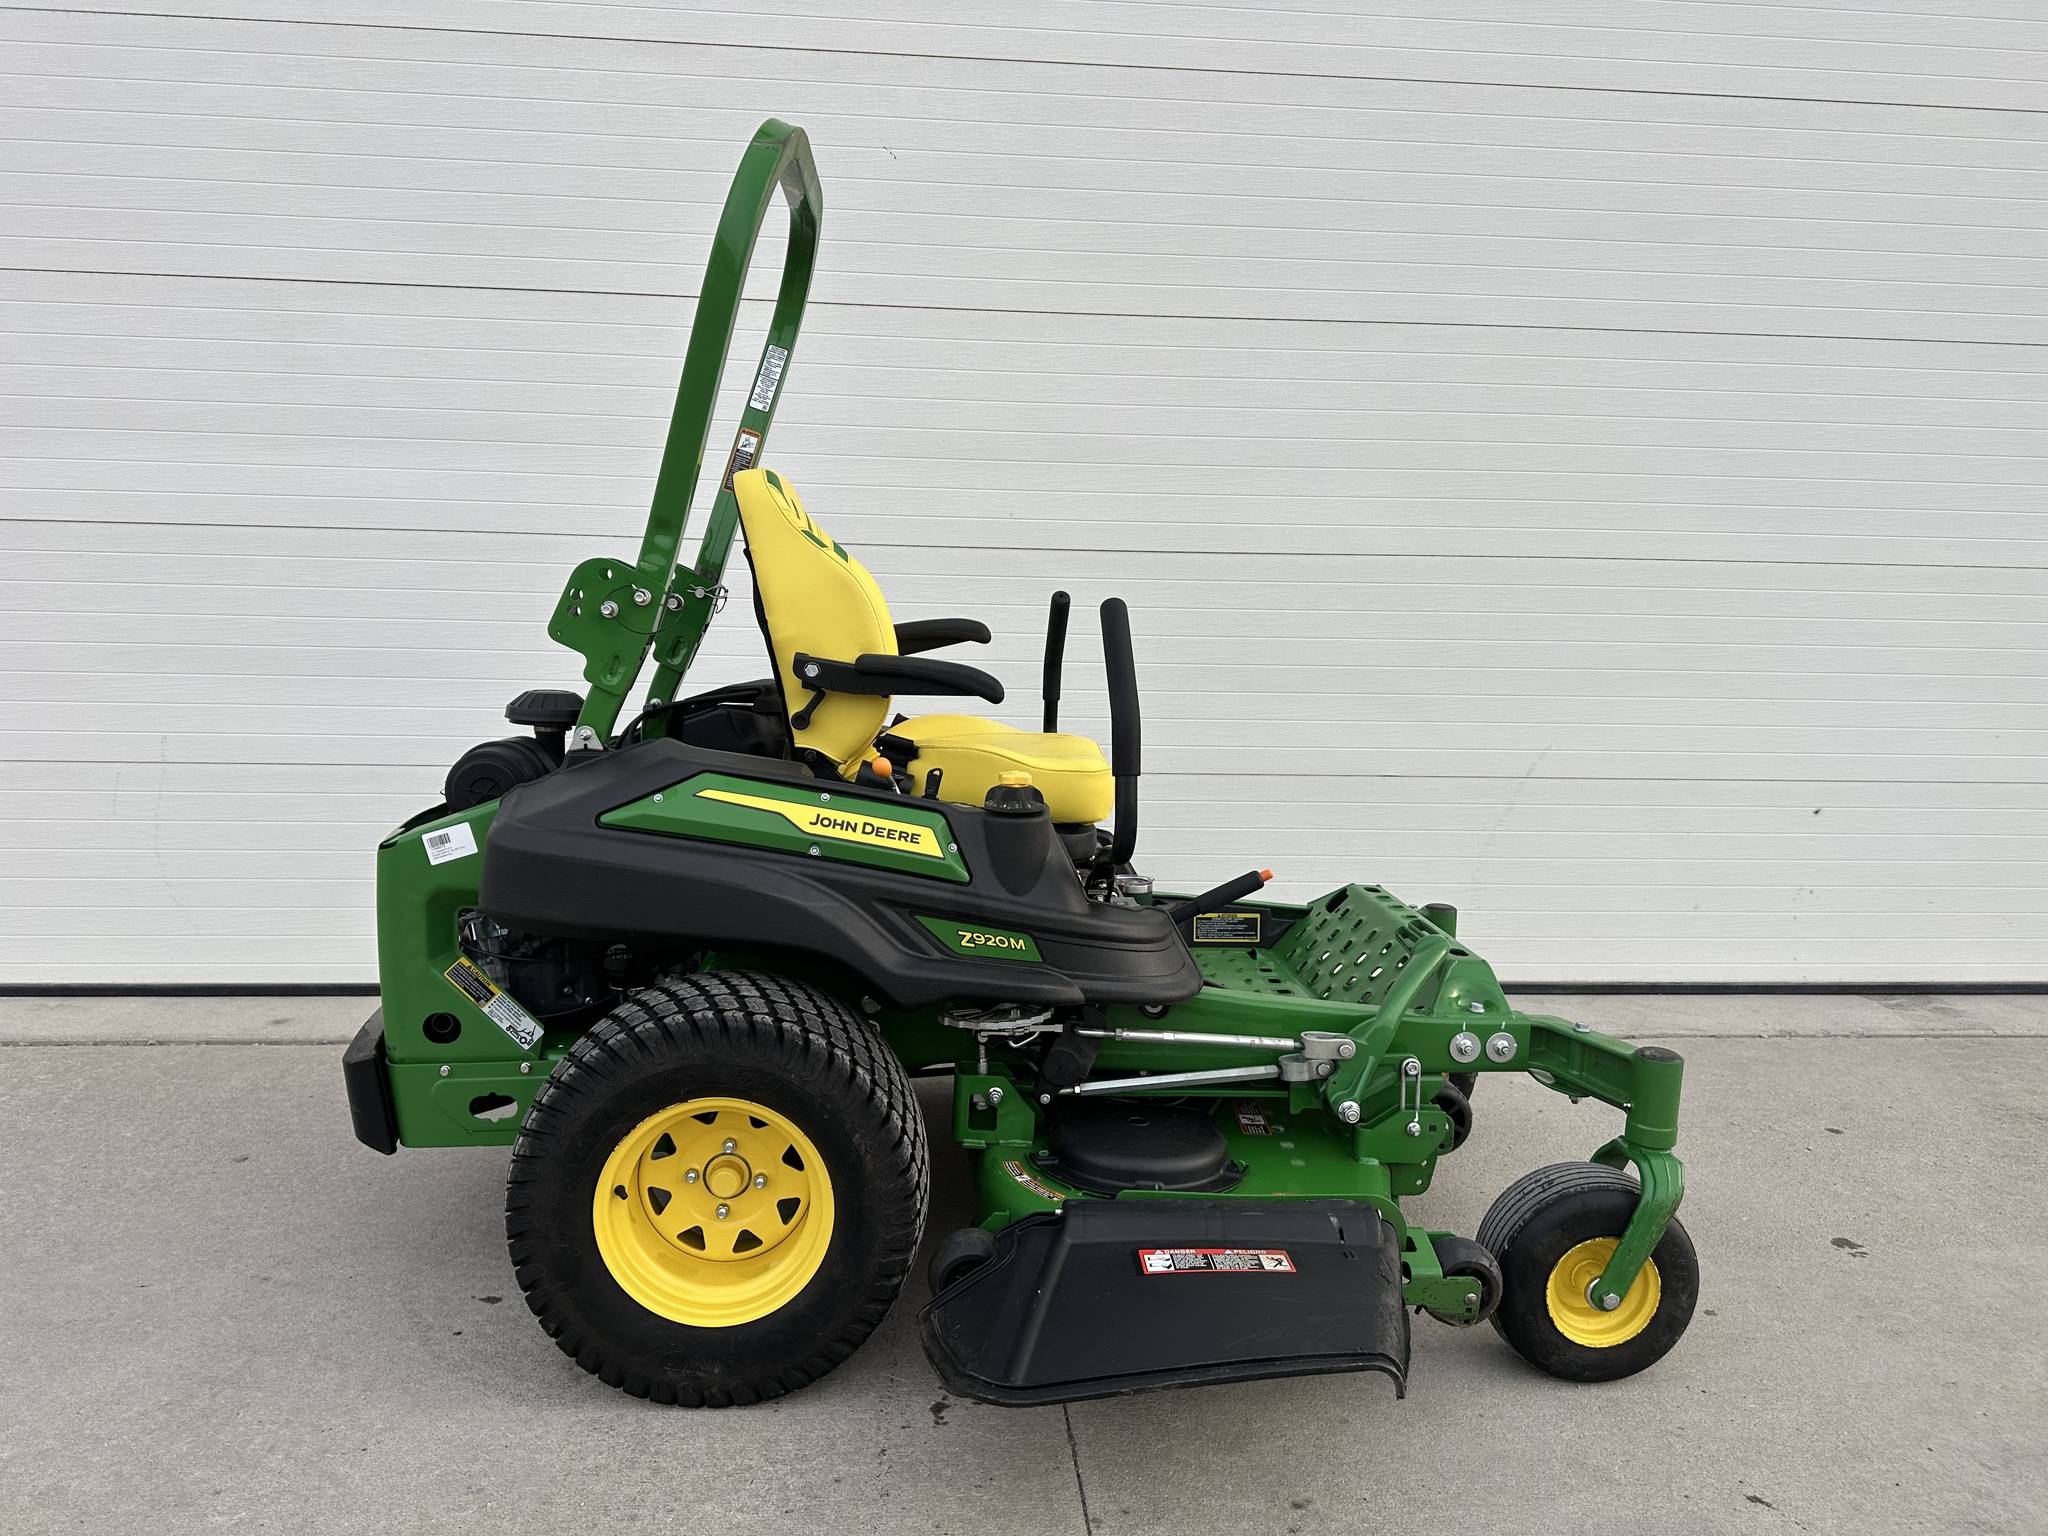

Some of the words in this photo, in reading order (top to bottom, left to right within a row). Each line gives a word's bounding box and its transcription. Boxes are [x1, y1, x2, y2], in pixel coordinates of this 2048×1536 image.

[809, 814, 858, 833] JOHN
[861, 822, 922, 845] DEERE
[957, 930, 1026, 951] Z920M
[471, 968, 492, 987] CAUTION
